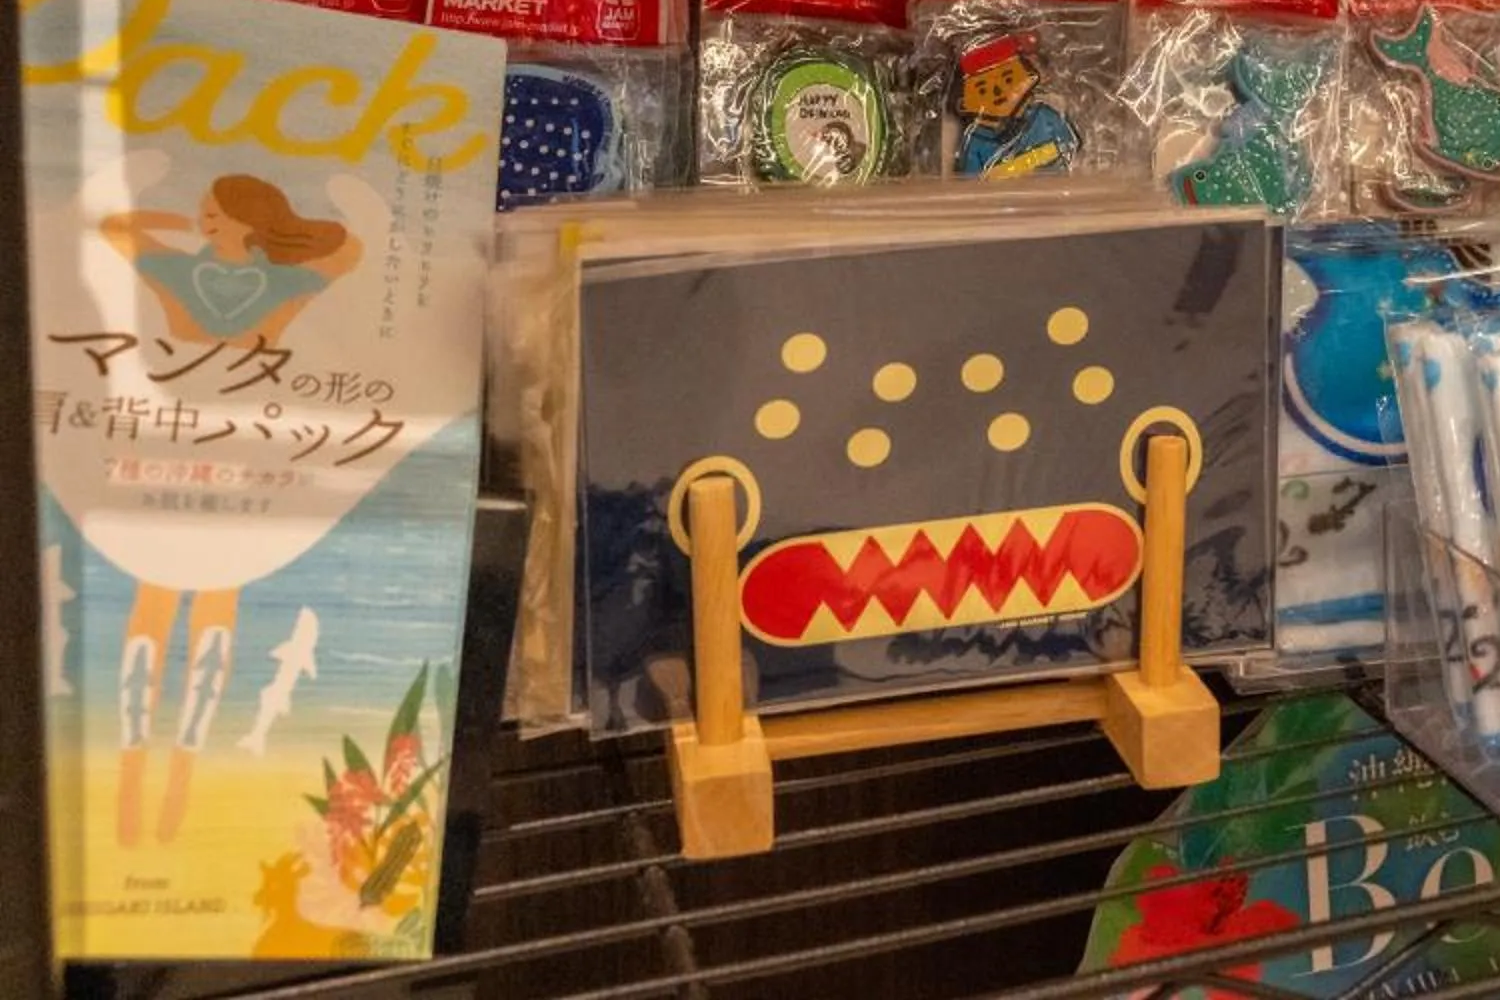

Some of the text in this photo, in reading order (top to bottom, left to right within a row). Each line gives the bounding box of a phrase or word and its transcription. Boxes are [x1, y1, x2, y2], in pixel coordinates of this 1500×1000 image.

[604, 7, 635, 21] JAM
[48, 332, 395, 403] マンタの形の
